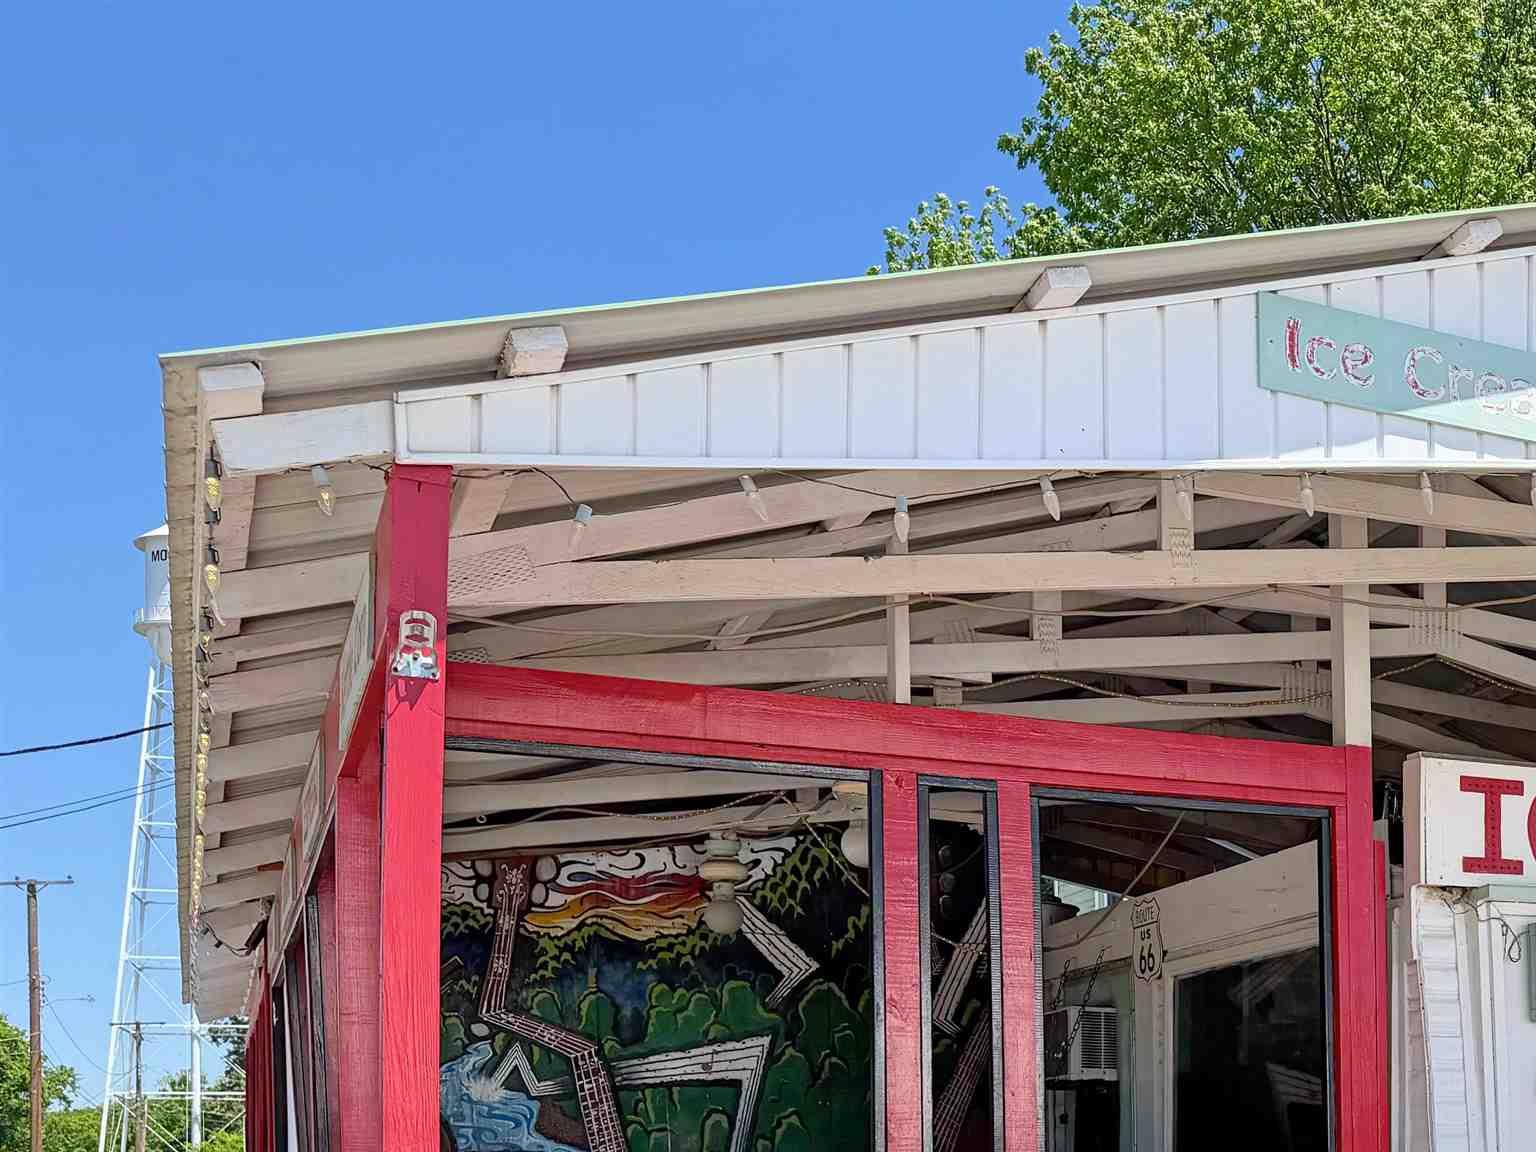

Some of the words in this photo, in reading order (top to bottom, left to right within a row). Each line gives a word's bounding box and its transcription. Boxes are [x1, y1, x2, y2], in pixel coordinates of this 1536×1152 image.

[1284, 316, 1375, 388] Ice
[1140, 928, 1152, 941] US
[1139, 943, 1156, 975] 66
